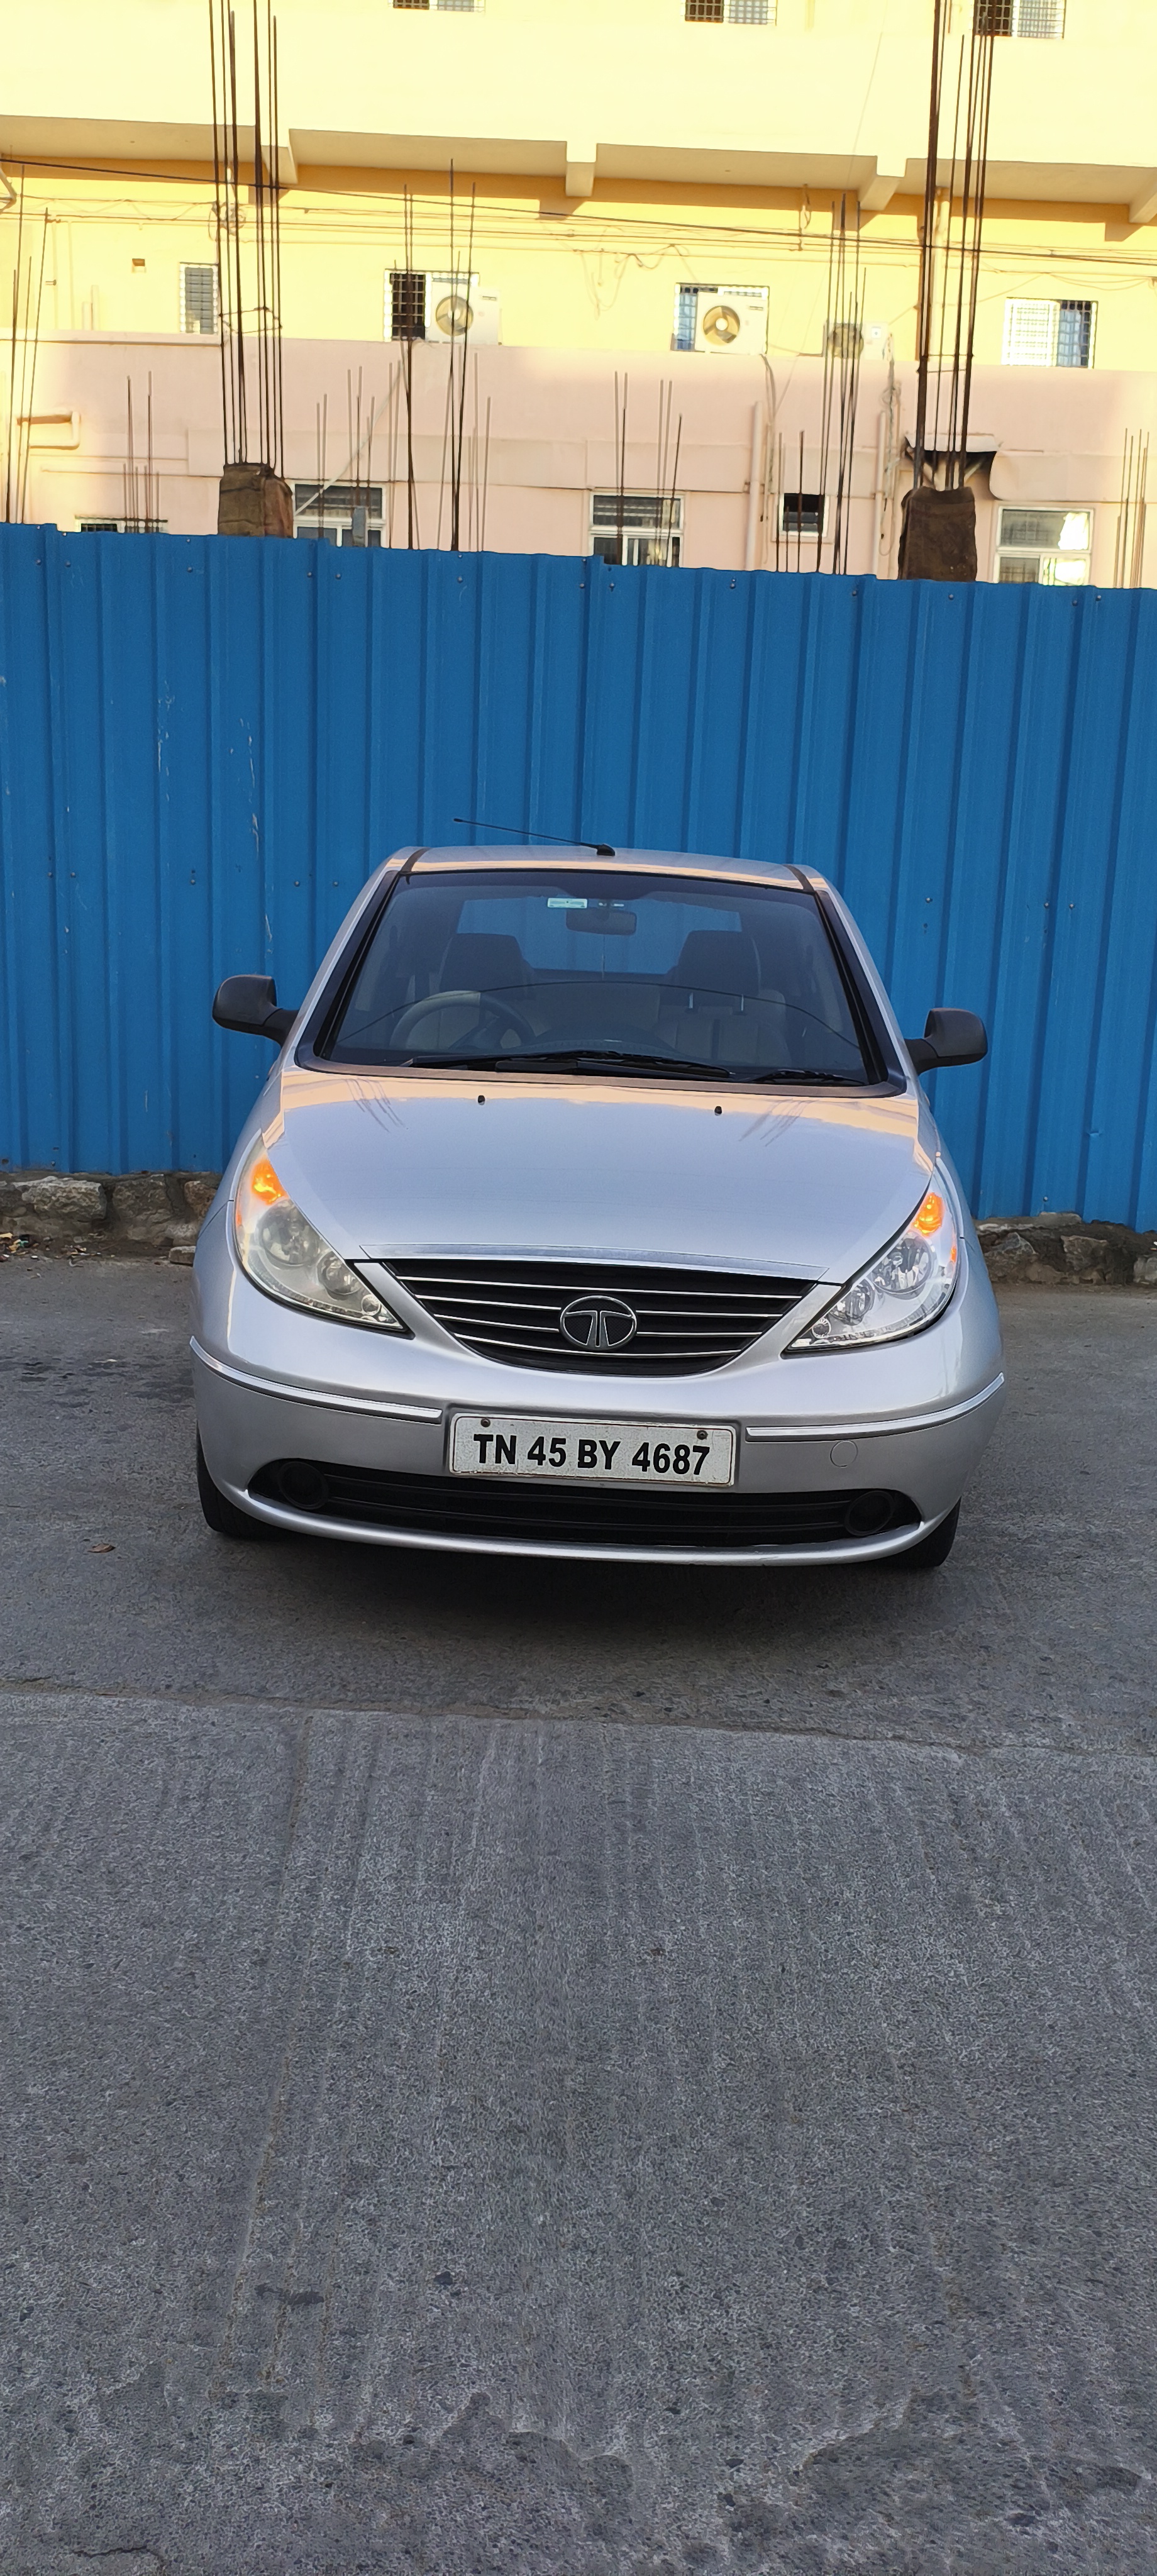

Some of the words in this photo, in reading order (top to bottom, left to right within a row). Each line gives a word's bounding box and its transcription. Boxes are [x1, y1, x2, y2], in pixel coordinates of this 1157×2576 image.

[473, 1433, 517, 1465] TN
[527, 1436, 567, 1467] 45
[577, 1439, 621, 1470] BY
[631, 1441, 711, 1475] 4687
